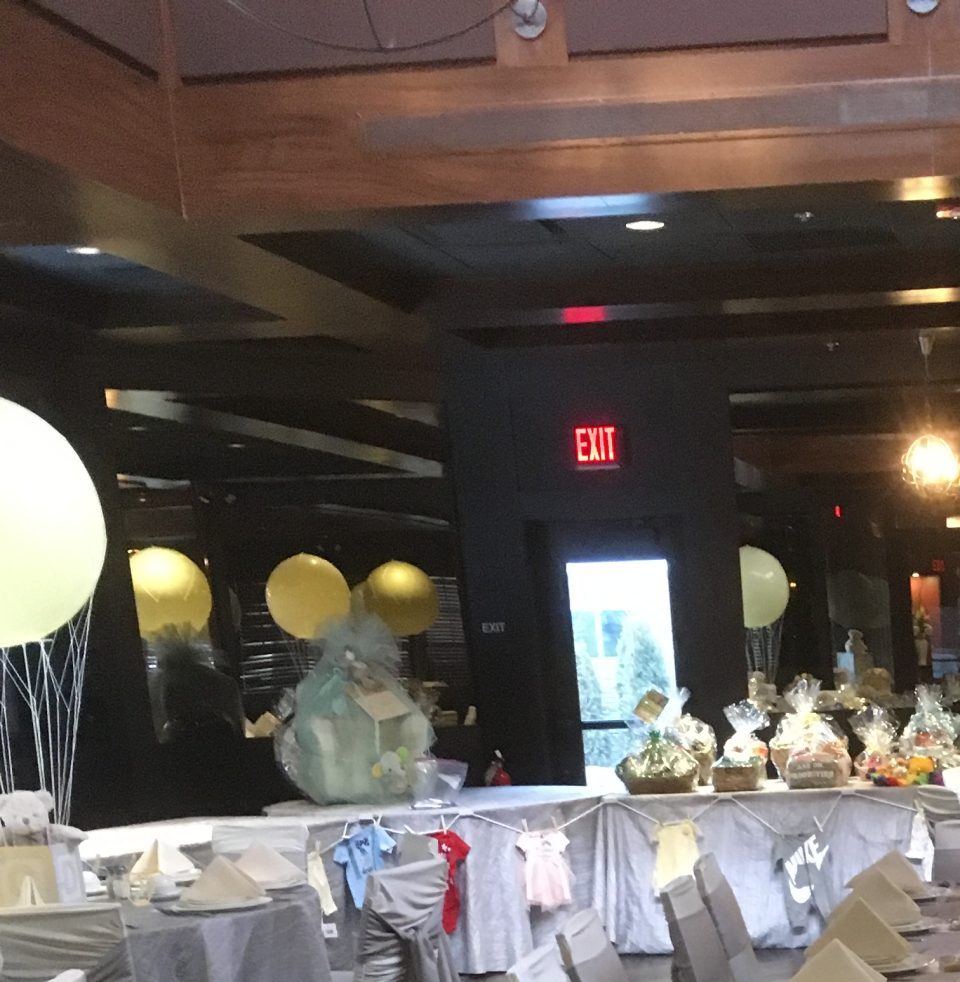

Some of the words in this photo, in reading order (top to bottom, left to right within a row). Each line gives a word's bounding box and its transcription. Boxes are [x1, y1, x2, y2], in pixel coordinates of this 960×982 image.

[575, 426, 615, 461] EXIT
[481, 621, 506, 633] EXIT
[784, 834, 829, 886] NIKE
